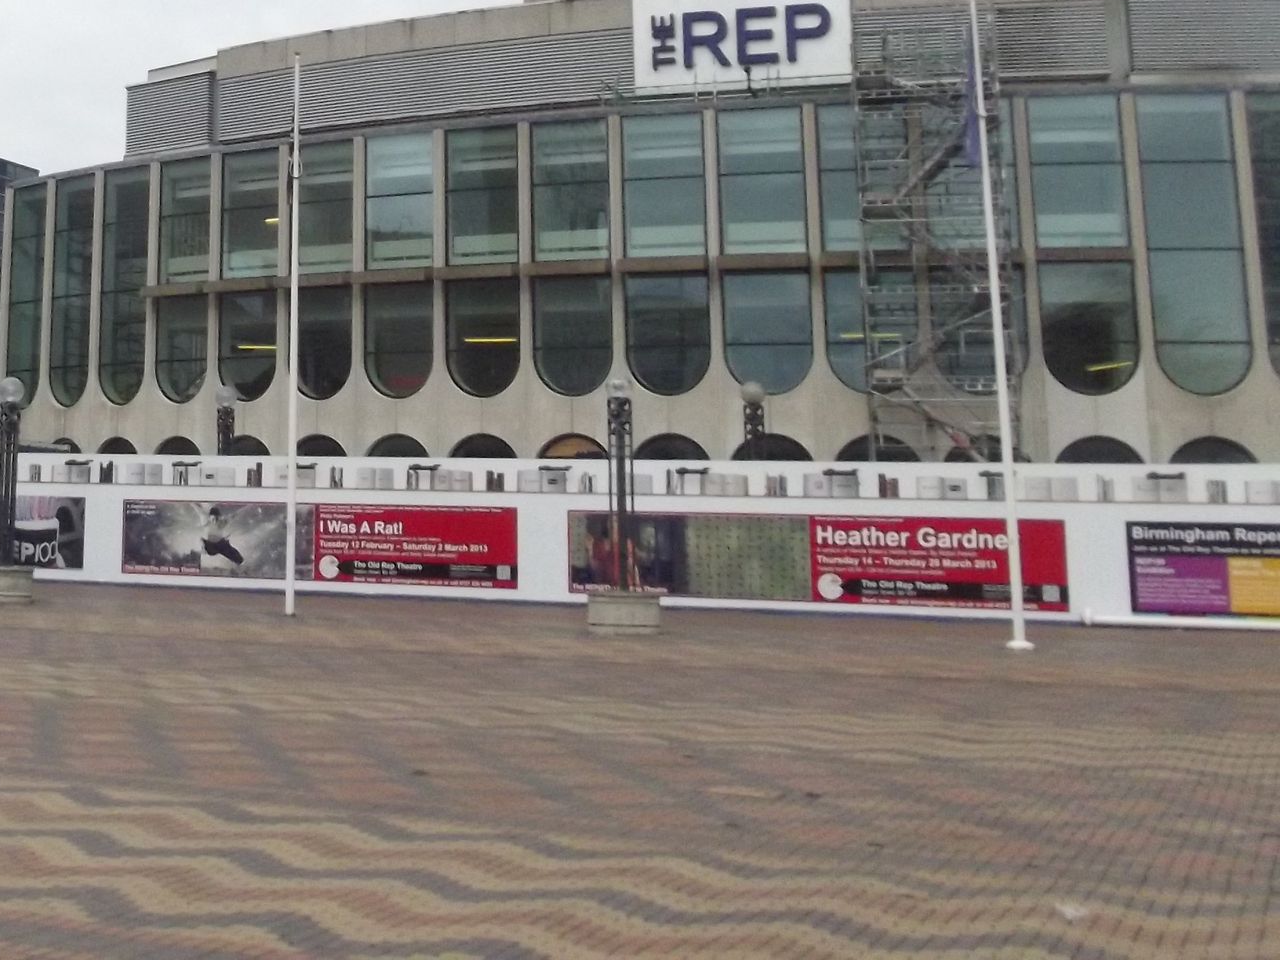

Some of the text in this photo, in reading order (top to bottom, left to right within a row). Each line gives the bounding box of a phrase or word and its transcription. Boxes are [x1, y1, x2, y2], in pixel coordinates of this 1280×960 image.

[651, 3, 831, 71] THE REP
[319, 520, 403, 535] I Was A Rat!
[1132, 526, 1230, 543] Birmingham
[320, 539, 349, 549] Tuesday
[361, 541, 394, 551] February
[403, 542, 436, 551] Saturday
[444, 543, 468, 552] March
[470, 544, 488, 553] 2013
[816, 525, 1009, 550] Heather Gardne
